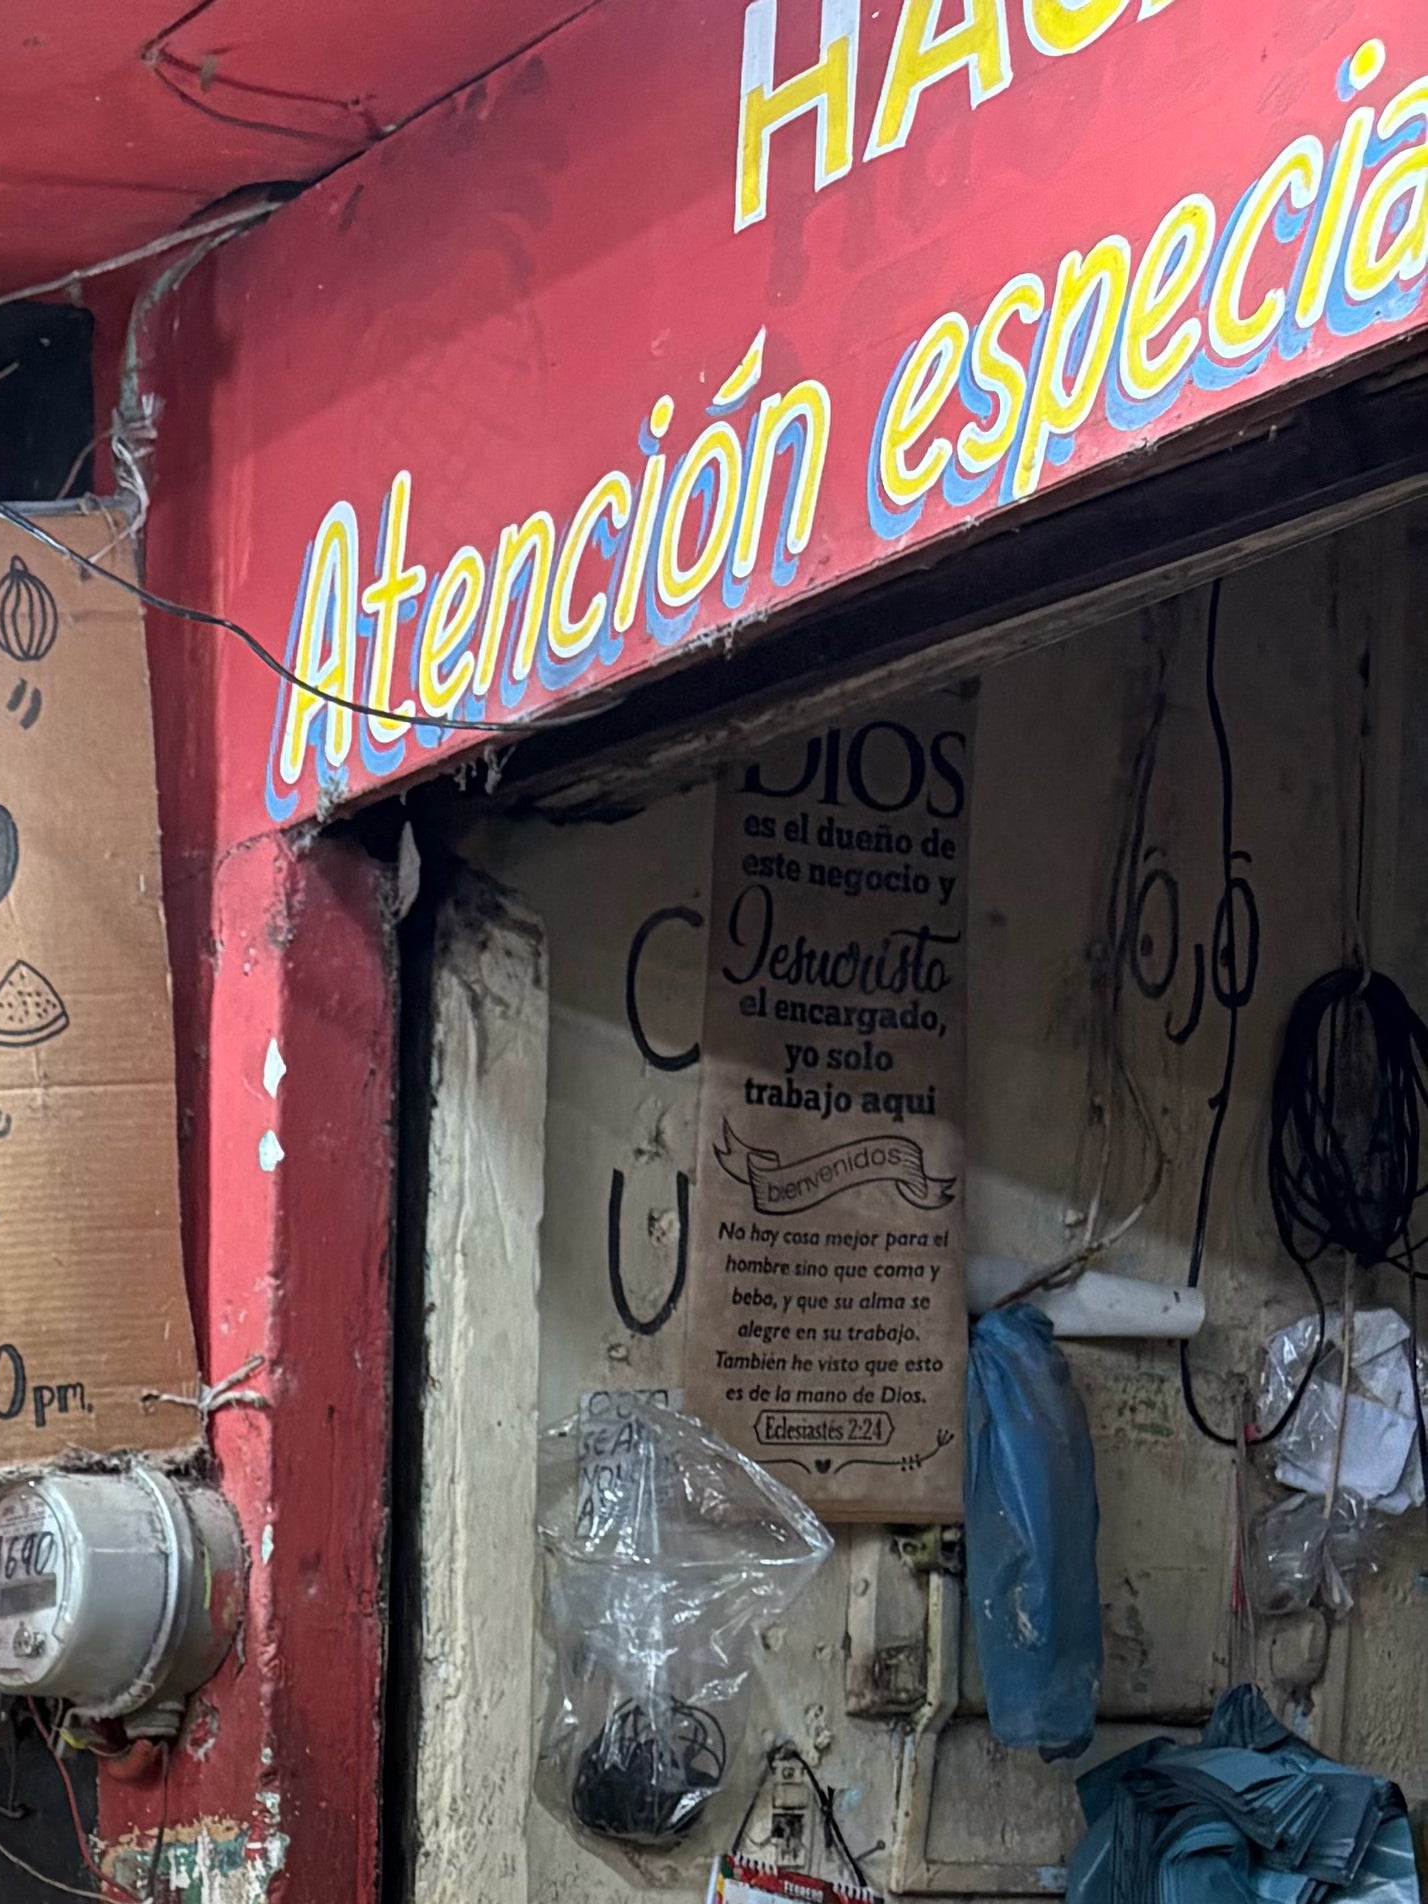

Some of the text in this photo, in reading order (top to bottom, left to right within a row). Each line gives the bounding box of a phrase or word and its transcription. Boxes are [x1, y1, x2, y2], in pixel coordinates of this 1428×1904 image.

[270, 325, 832, 812] Atención
[745, 813, 955, 859] es el dueño de
[742, 853, 955, 905] este negocio y
[722, 884, 961, 995] Jesucristo
[740, 986, 946, 1038] el encargado,
[785, 1041, 893, 1073] yo solo
[745, 1078, 852, 1119] trabajo
[767, 1147, 902, 1202] bienvenidos
[718, 1222, 948, 1250] No hay cosa mejor para el
[726, 1255, 940, 1282] hombre sino que coma y
[782, 1297, 791, 1313] y
[797, 1296, 828, 1314] que
[834, 1298, 853, 1310] su
[859, 1292, 905, 1310] alma
[910, 1296, 930, 1310] se
[738, 1320, 920, 1345] alegre en su trabajo.
[716, 1351, 943, 1376] También he visto que esto
[726, 1385, 927, 1404] es de la mano de Dios.
[765, 1416, 844, 1440] Eclesiastés
